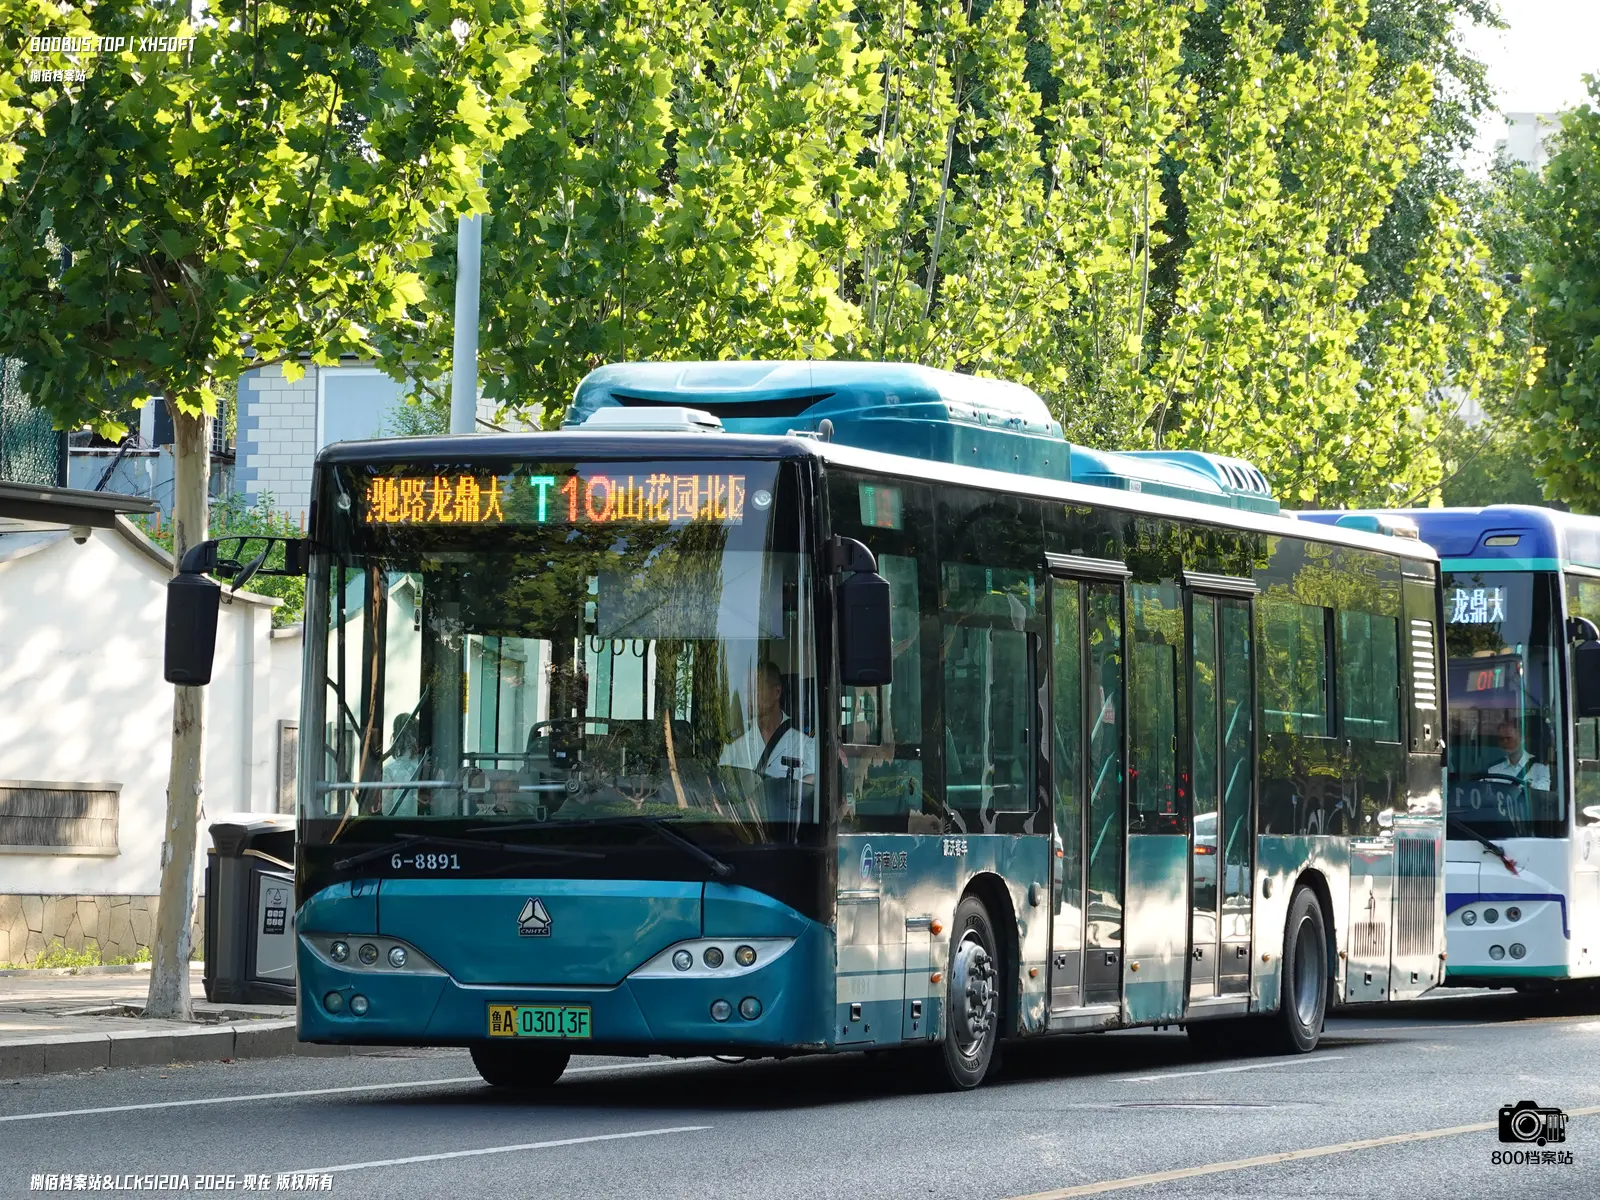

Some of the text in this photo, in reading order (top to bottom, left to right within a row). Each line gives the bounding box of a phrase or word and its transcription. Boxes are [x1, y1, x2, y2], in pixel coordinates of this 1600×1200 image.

[366, 475, 503, 522] 驰路龙鼎大
[610, 474, 746, 521] 山花园北区
[1451, 588, 1504, 624] 龙鼎大
[391, 853, 461, 870] 6-8891
[520, 927, 549, 935] CNHTC
